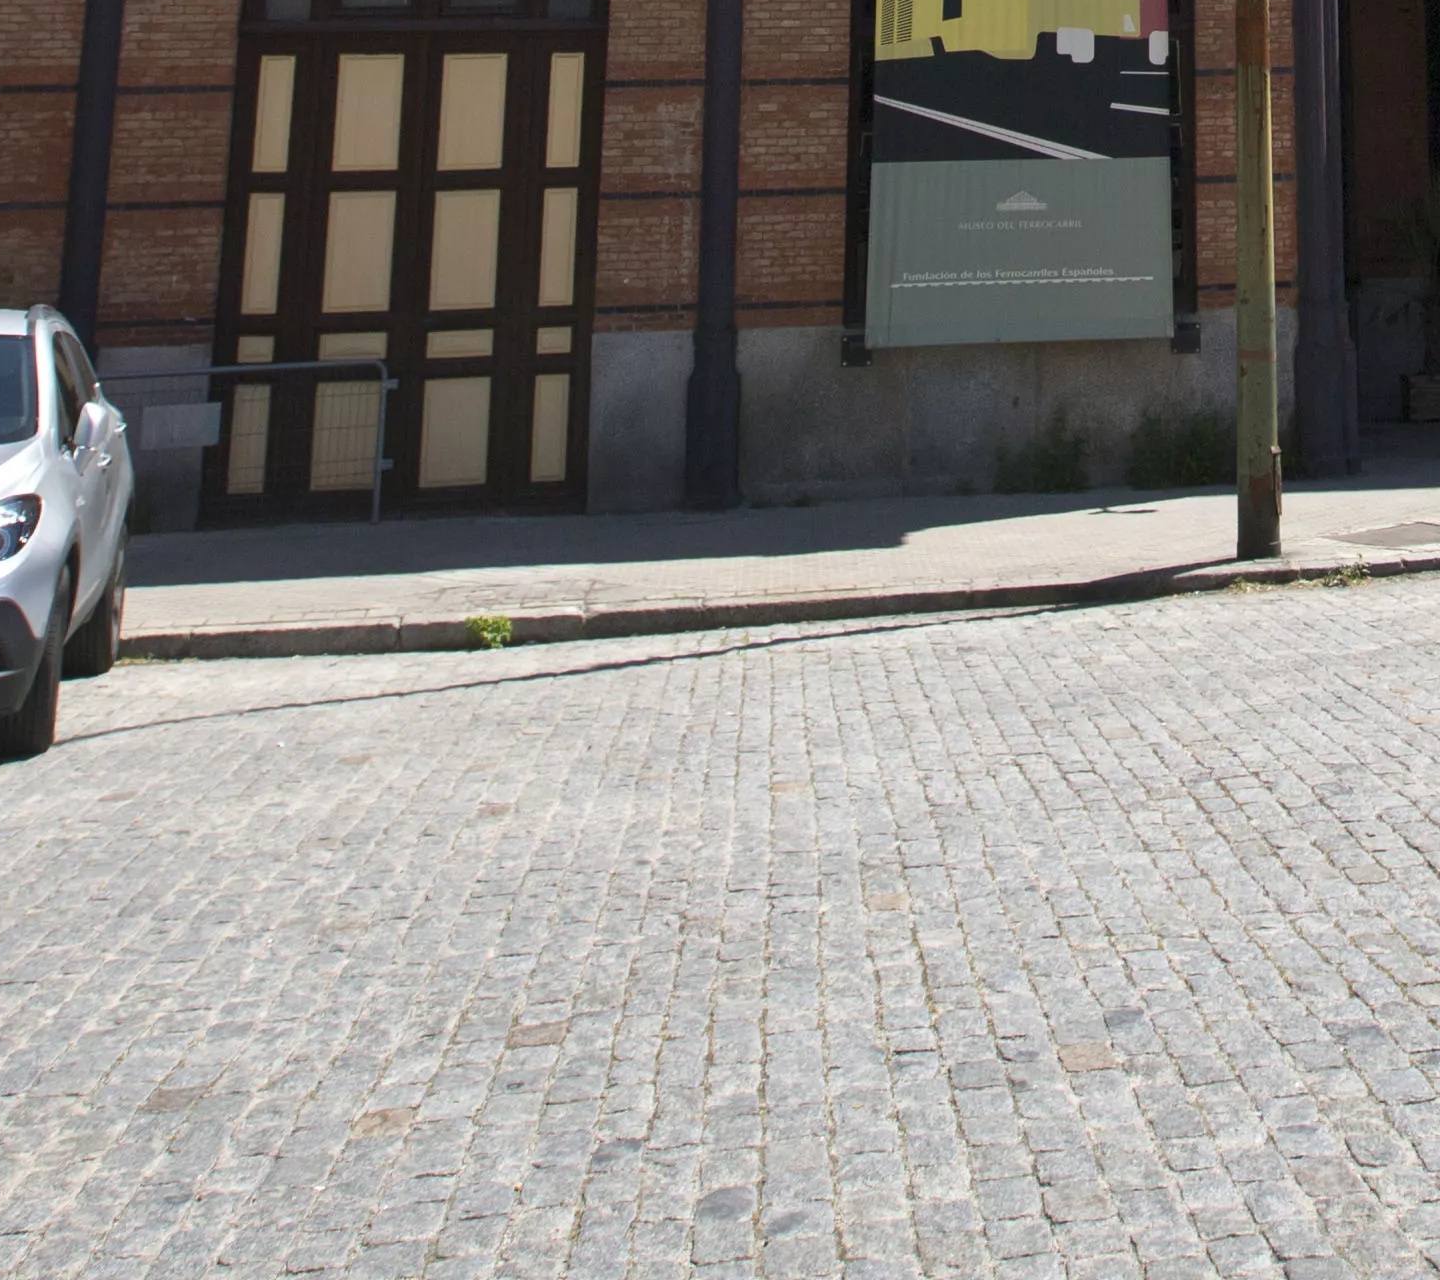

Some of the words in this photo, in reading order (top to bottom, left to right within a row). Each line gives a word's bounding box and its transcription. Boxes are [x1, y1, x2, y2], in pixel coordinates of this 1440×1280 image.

[958, 221, 994, 230] MUSEO
[997, 220, 1014, 230] DEL
[1018, 219, 1082, 229] FERROCARRIL
[902, 270, 958, 282] Fundación
[960, 270, 973, 280] de
[976, 269, 992, 279] los
[995, 267, 1059, 279] Ferrocarriles
[1062, 266, 1115, 278] Españoles
